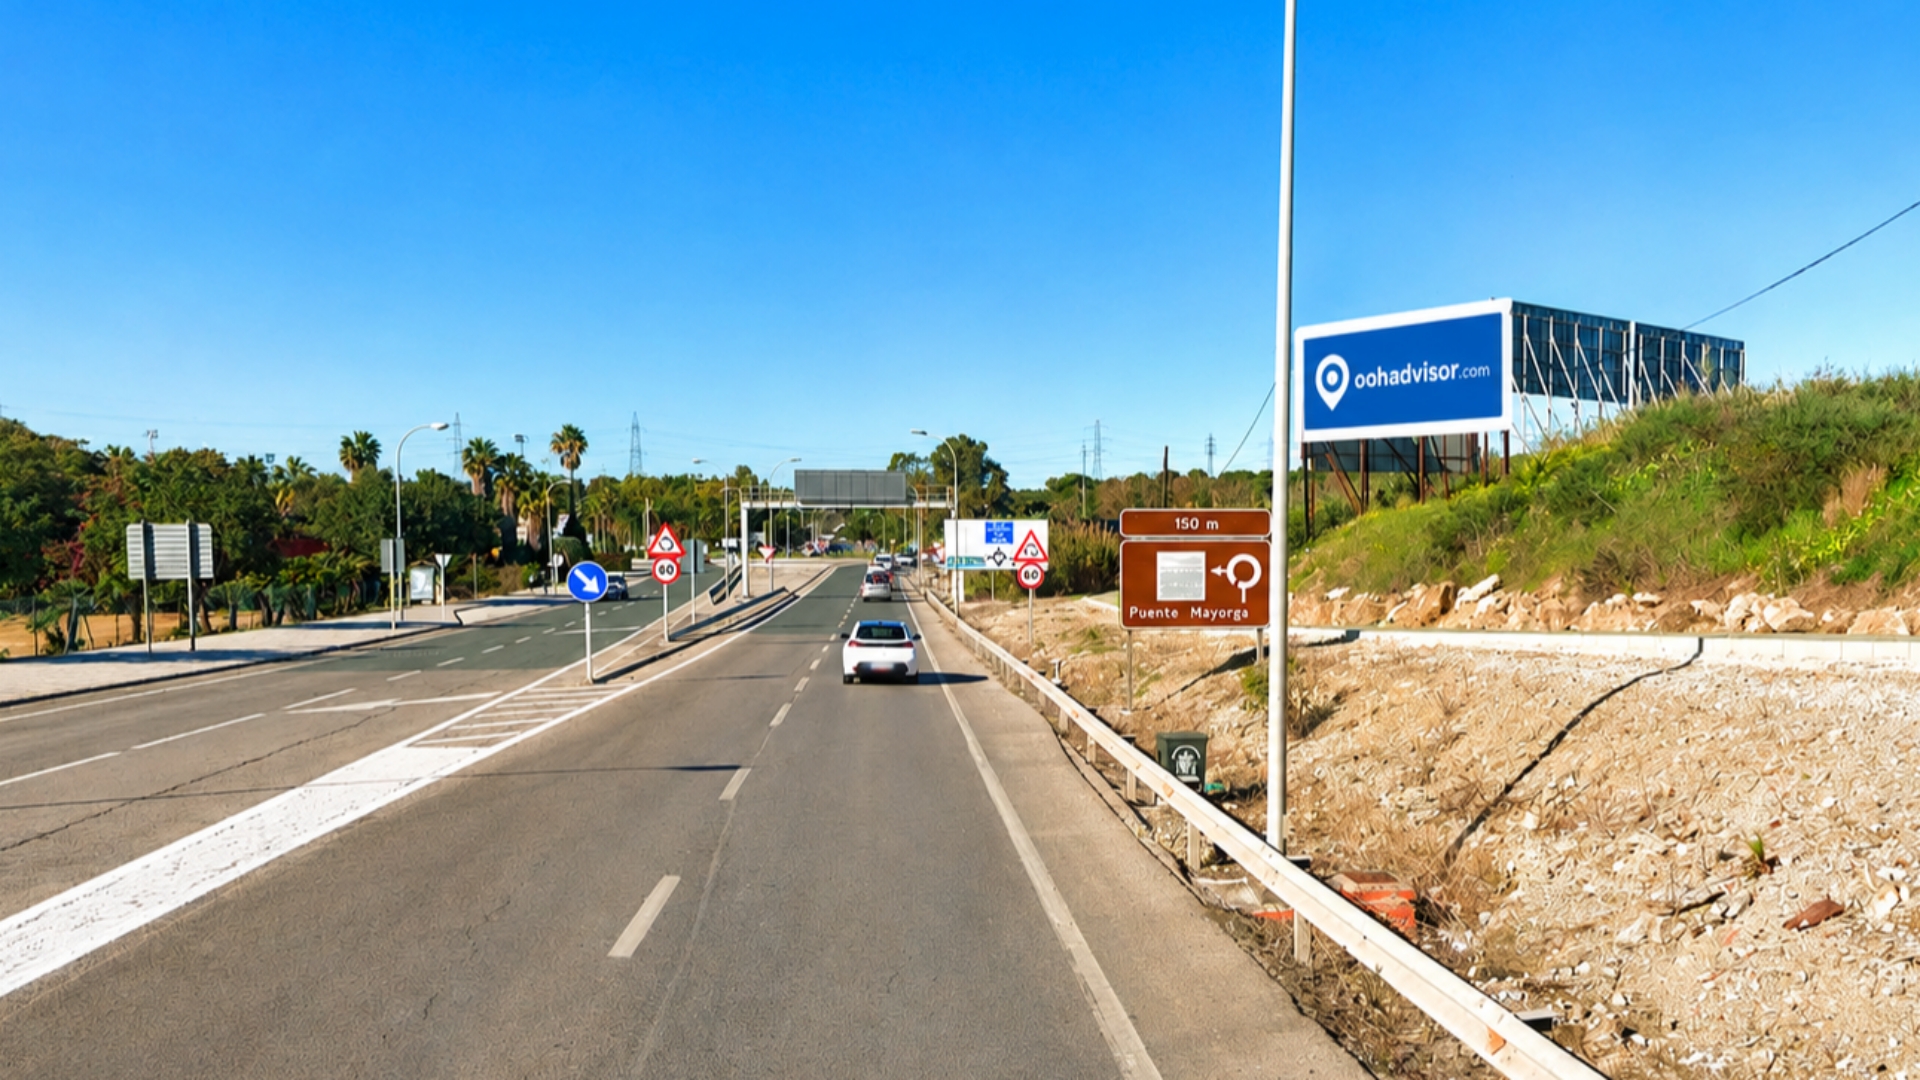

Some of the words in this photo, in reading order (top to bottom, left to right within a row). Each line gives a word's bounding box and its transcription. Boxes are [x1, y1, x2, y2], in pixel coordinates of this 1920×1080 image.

[1354, 361, 1490, 389] oohadvisor.com
[1175, 517, 1199, 530] 150
[1206, 519, 1219, 530] m
[658, 564, 674, 575] 60
[1129, 606, 1179, 618] Puente
[1190, 606, 1249, 622] Mayorga
